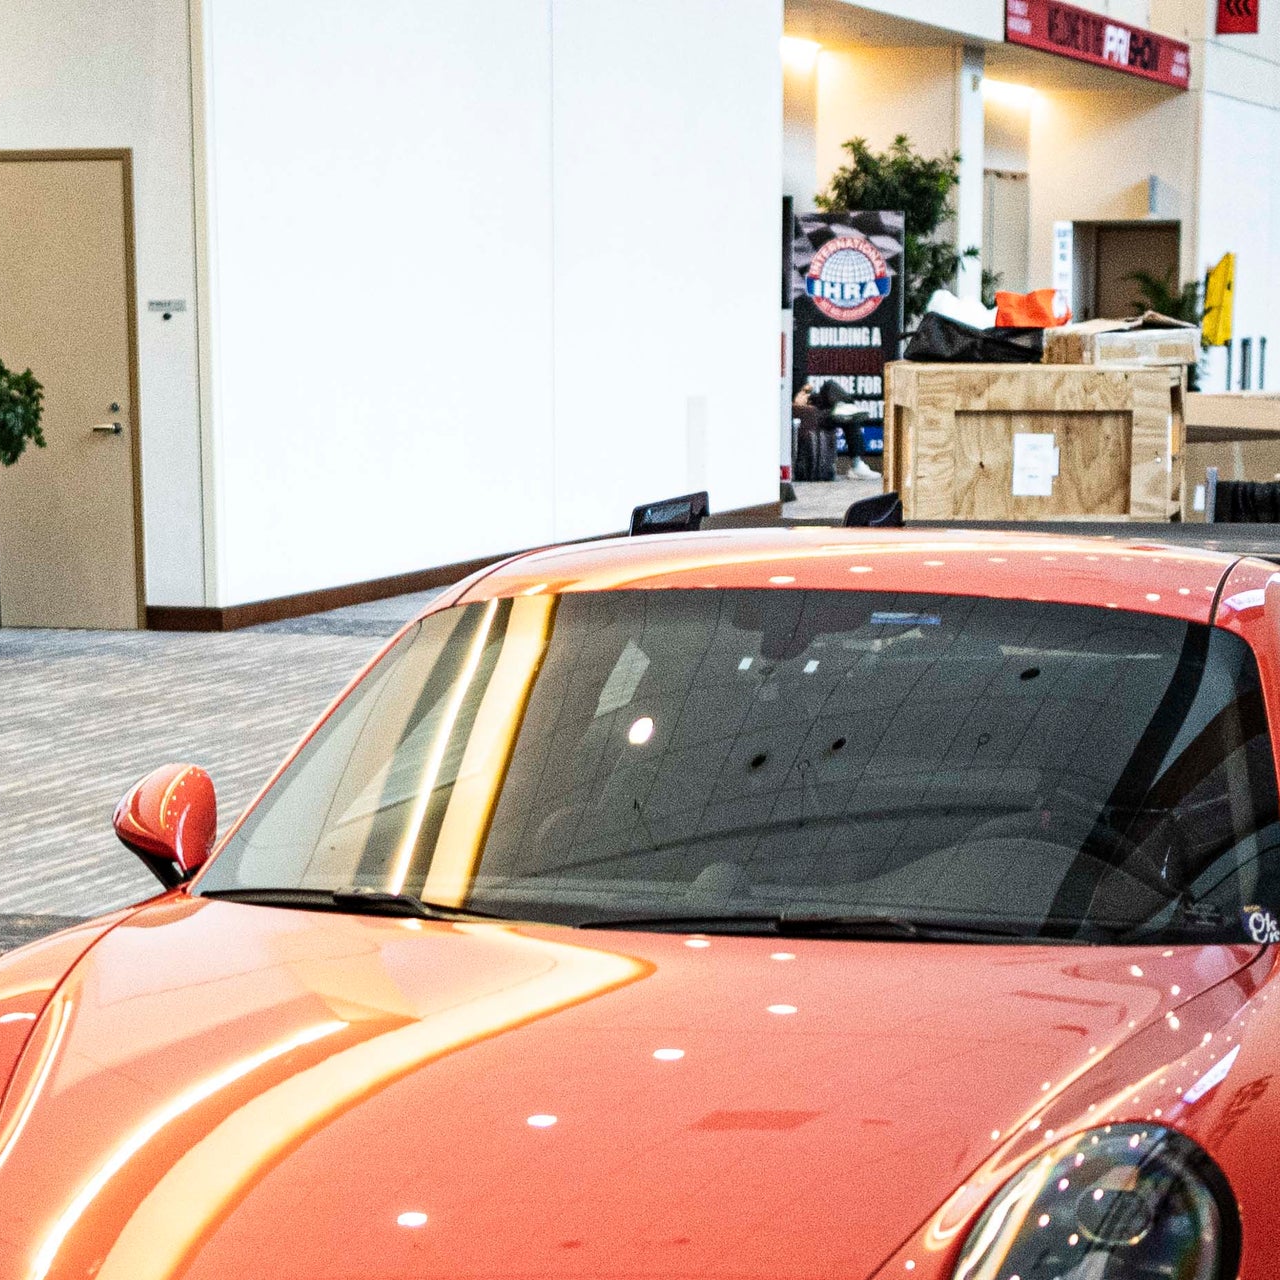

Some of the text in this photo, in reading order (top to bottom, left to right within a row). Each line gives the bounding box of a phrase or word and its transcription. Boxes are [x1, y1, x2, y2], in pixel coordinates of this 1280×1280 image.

[812, 279, 880, 300] IHRA
[809, 326, 882, 346] BUILDING A
[857, 375, 882, 394] FOR
